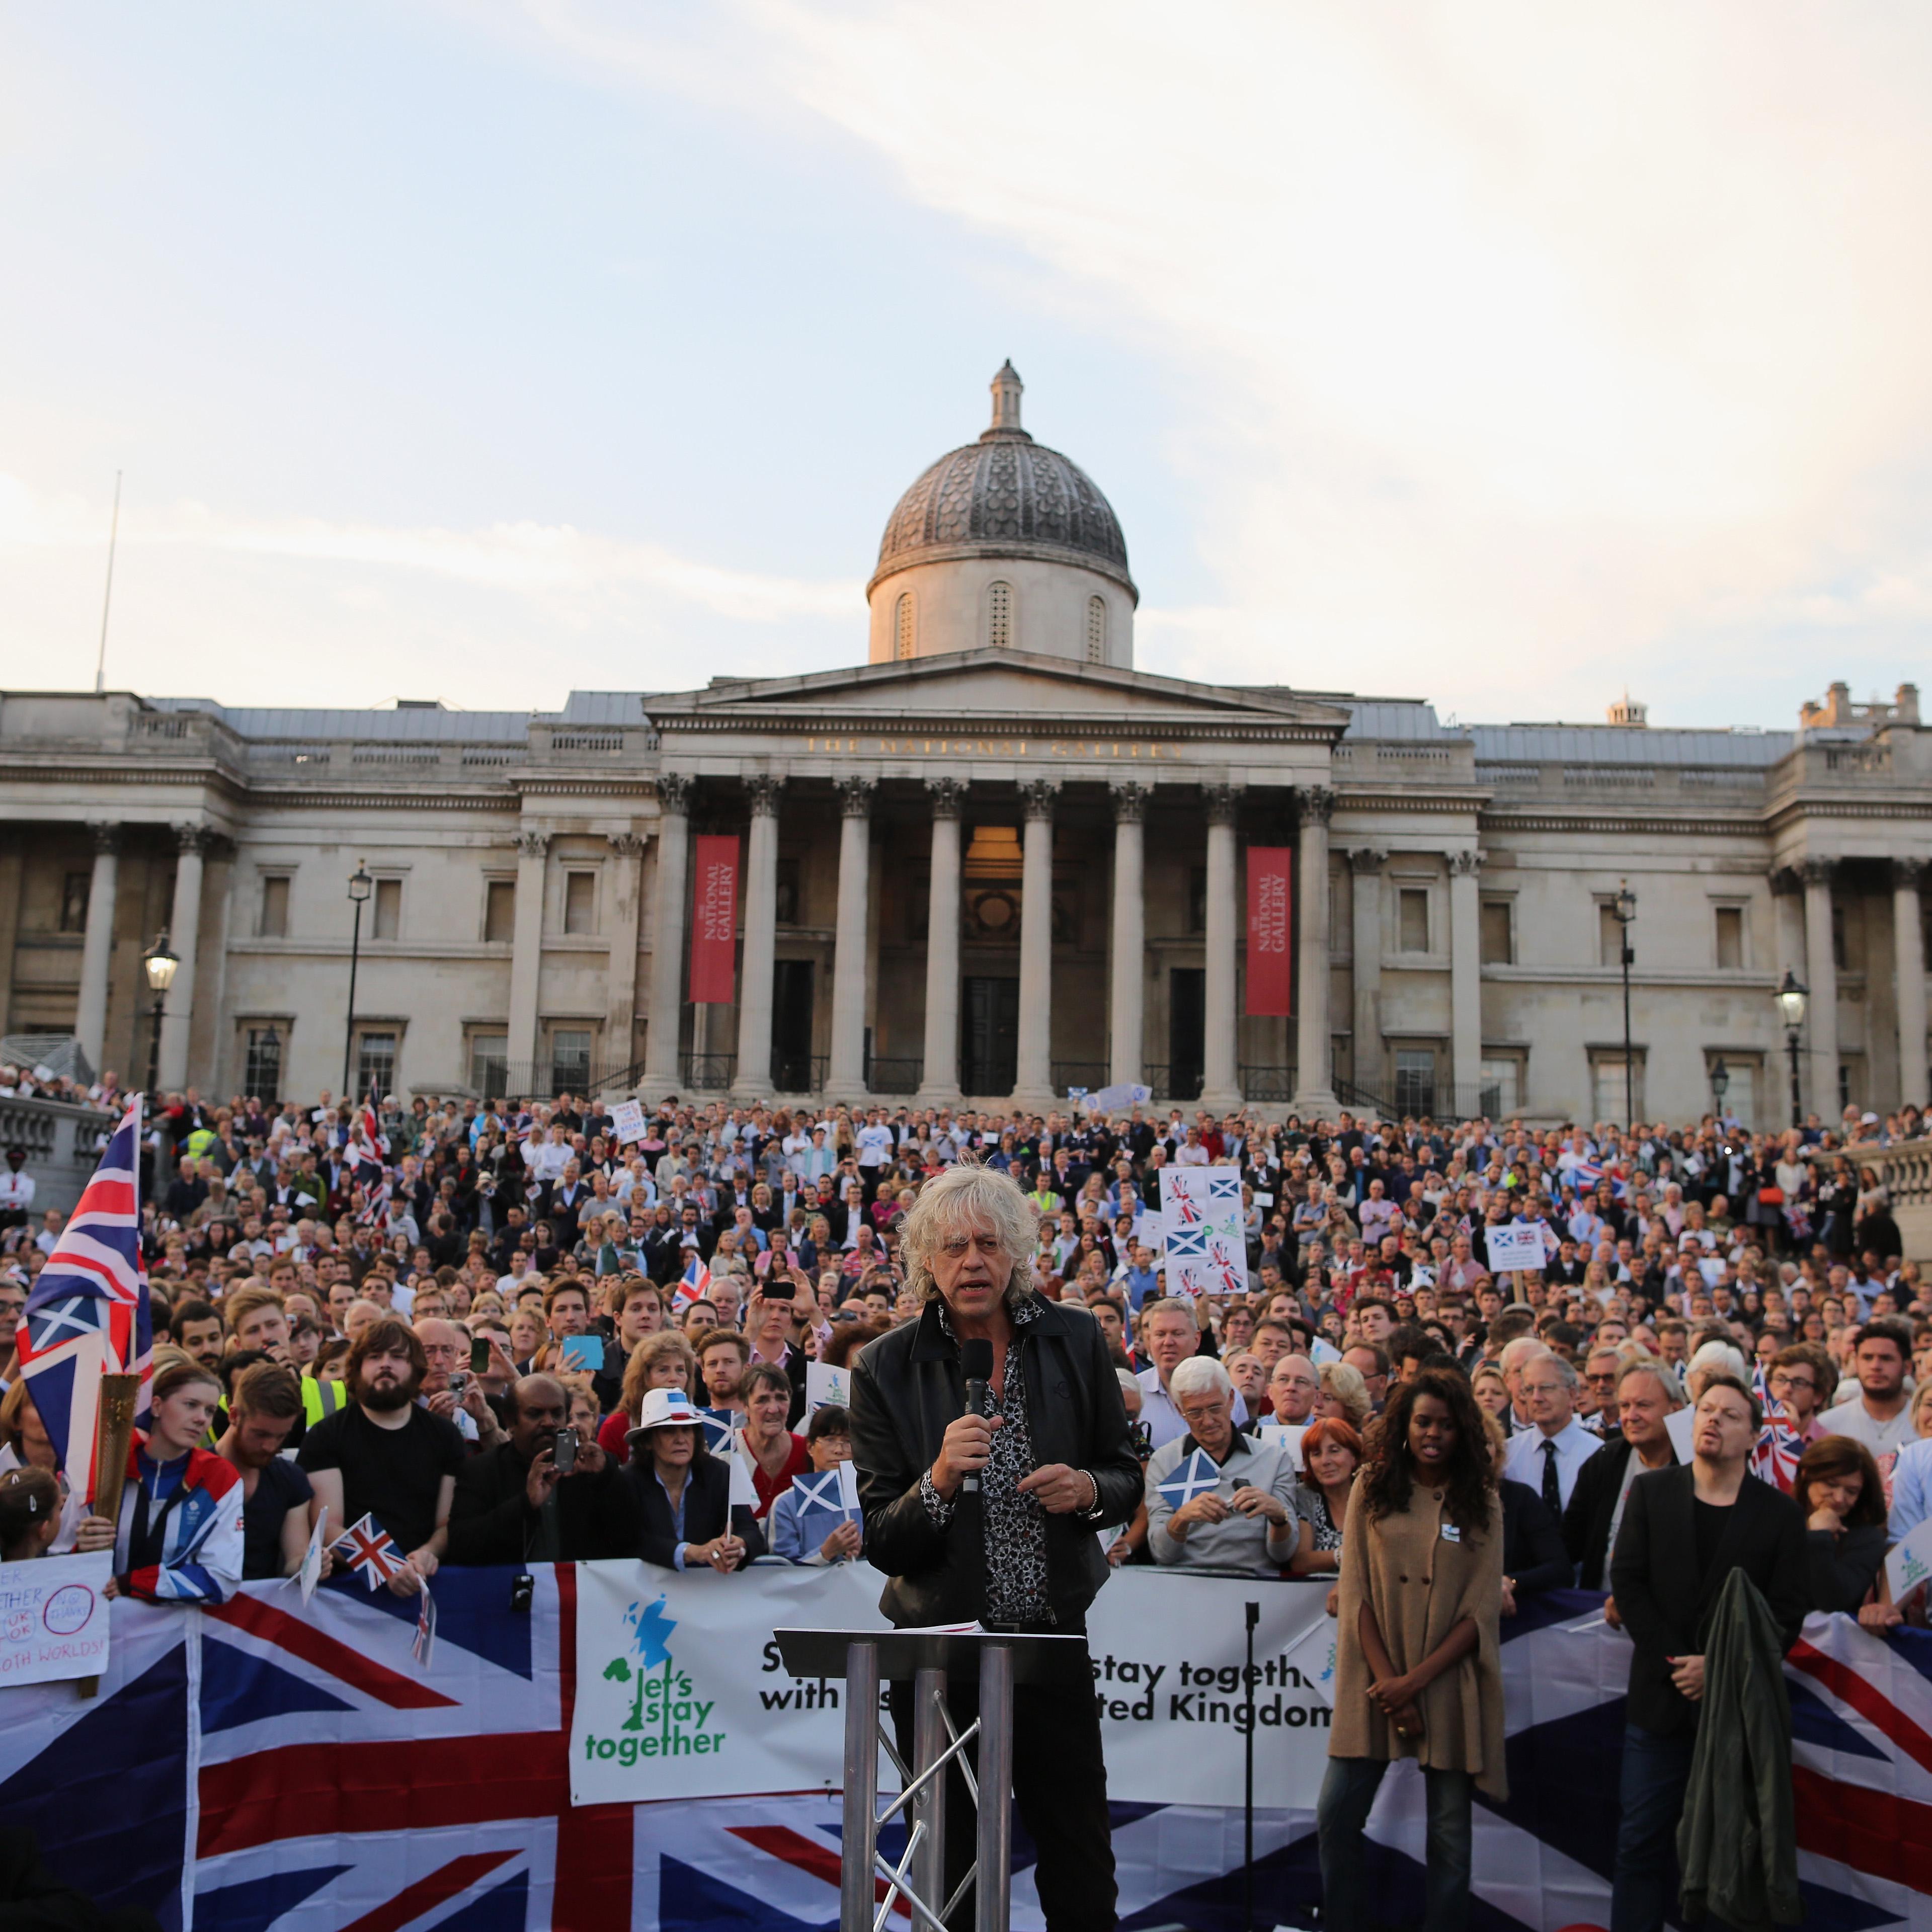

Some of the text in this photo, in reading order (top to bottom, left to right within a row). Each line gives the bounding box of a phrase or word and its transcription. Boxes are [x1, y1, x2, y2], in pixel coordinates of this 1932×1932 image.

[803, 736, 1186, 759] THE NATIONAL GALLERY
[704, 862, 719, 940] NATIONAL
[716, 863, 733, 942] GALLERY
[1258, 872, 1272, 952] NATIONAL
[1271, 874, 1286, 953] GALLERY
[1, 1568, 22, 1584] ER
[9, 1611, 29, 1627] UK
[10, 1625, 30, 1640] OK
[0, 1649, 31, 1672] OTH
[39, 1639, 105, 1662] WORLDS!
[1180, 1654, 1315, 1694] togeth
[646, 1700, 715, 1730] stay
[759, 1678, 839, 1710] with
[1097, 1693, 1154, 1721] ted
[1170, 1692, 1334, 1734] Kingdom
[586, 1725, 727, 1767] together
